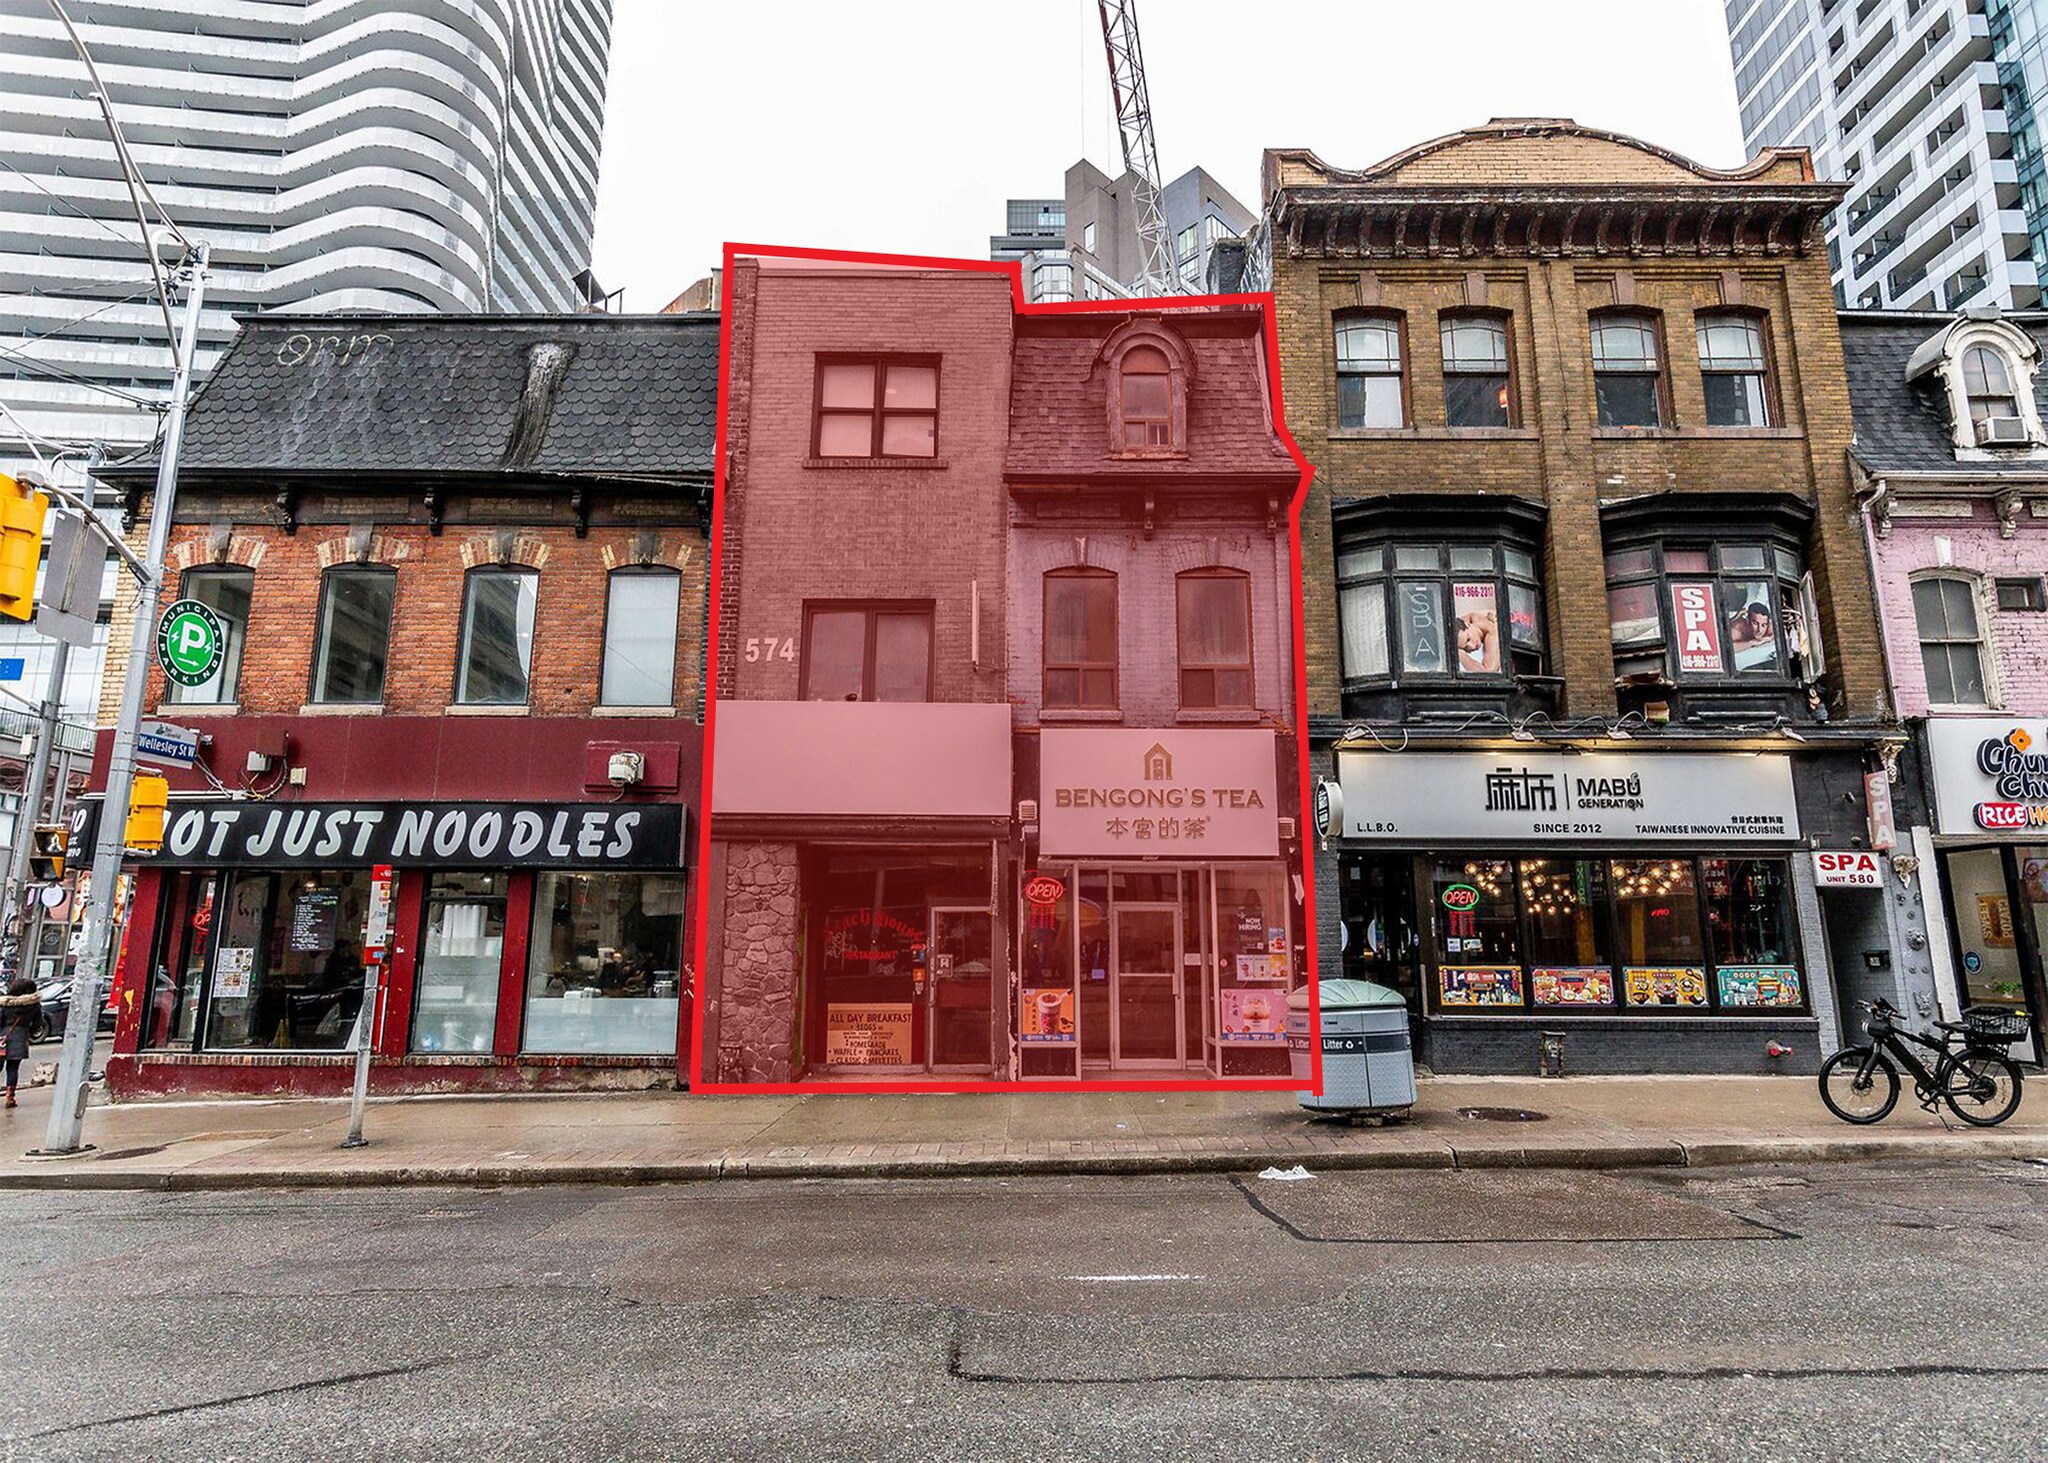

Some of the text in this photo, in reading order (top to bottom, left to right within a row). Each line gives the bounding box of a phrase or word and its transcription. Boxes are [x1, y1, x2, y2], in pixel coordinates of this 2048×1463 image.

[161, 604, 222, 649] MUNICIPAL
[1680, 588, 1712, 651] SPA
[178, 620, 206, 655] P
[744, 637, 795, 663] 574
[159, 642, 219, 683] PARKING
[139, 736, 178, 757] Wellesley
[178, 744, 187, 756] St
[188, 746, 196, 758] W
[1055, 788, 1265, 809] BENGONG'S TEA
[1578, 798, 1644, 811] GENERATION
[1869, 776, 1894, 845] SPA
[1981, 804, 2026, 825] RICE
[246, 809, 384, 857] JUST
[391, 810, 641, 859] NOODLES
[1357, 822, 1398, 832] L.L.B.O.
[1533, 823, 1602, 833] SINCE 2012
[1636, 825, 1785, 834] TAIWANESE INNOVATIVE CUISINE
[1819, 854, 1877, 872] SPA
[1849, 874, 1874, 884] 580
[1027, 883, 1060, 898] OPEN
[1445, 891, 1476, 904] OPEN
[830, 1013, 911, 1023] ALL DAY BREAKFAST
[1323, 1039, 1343, 1050] Litter
